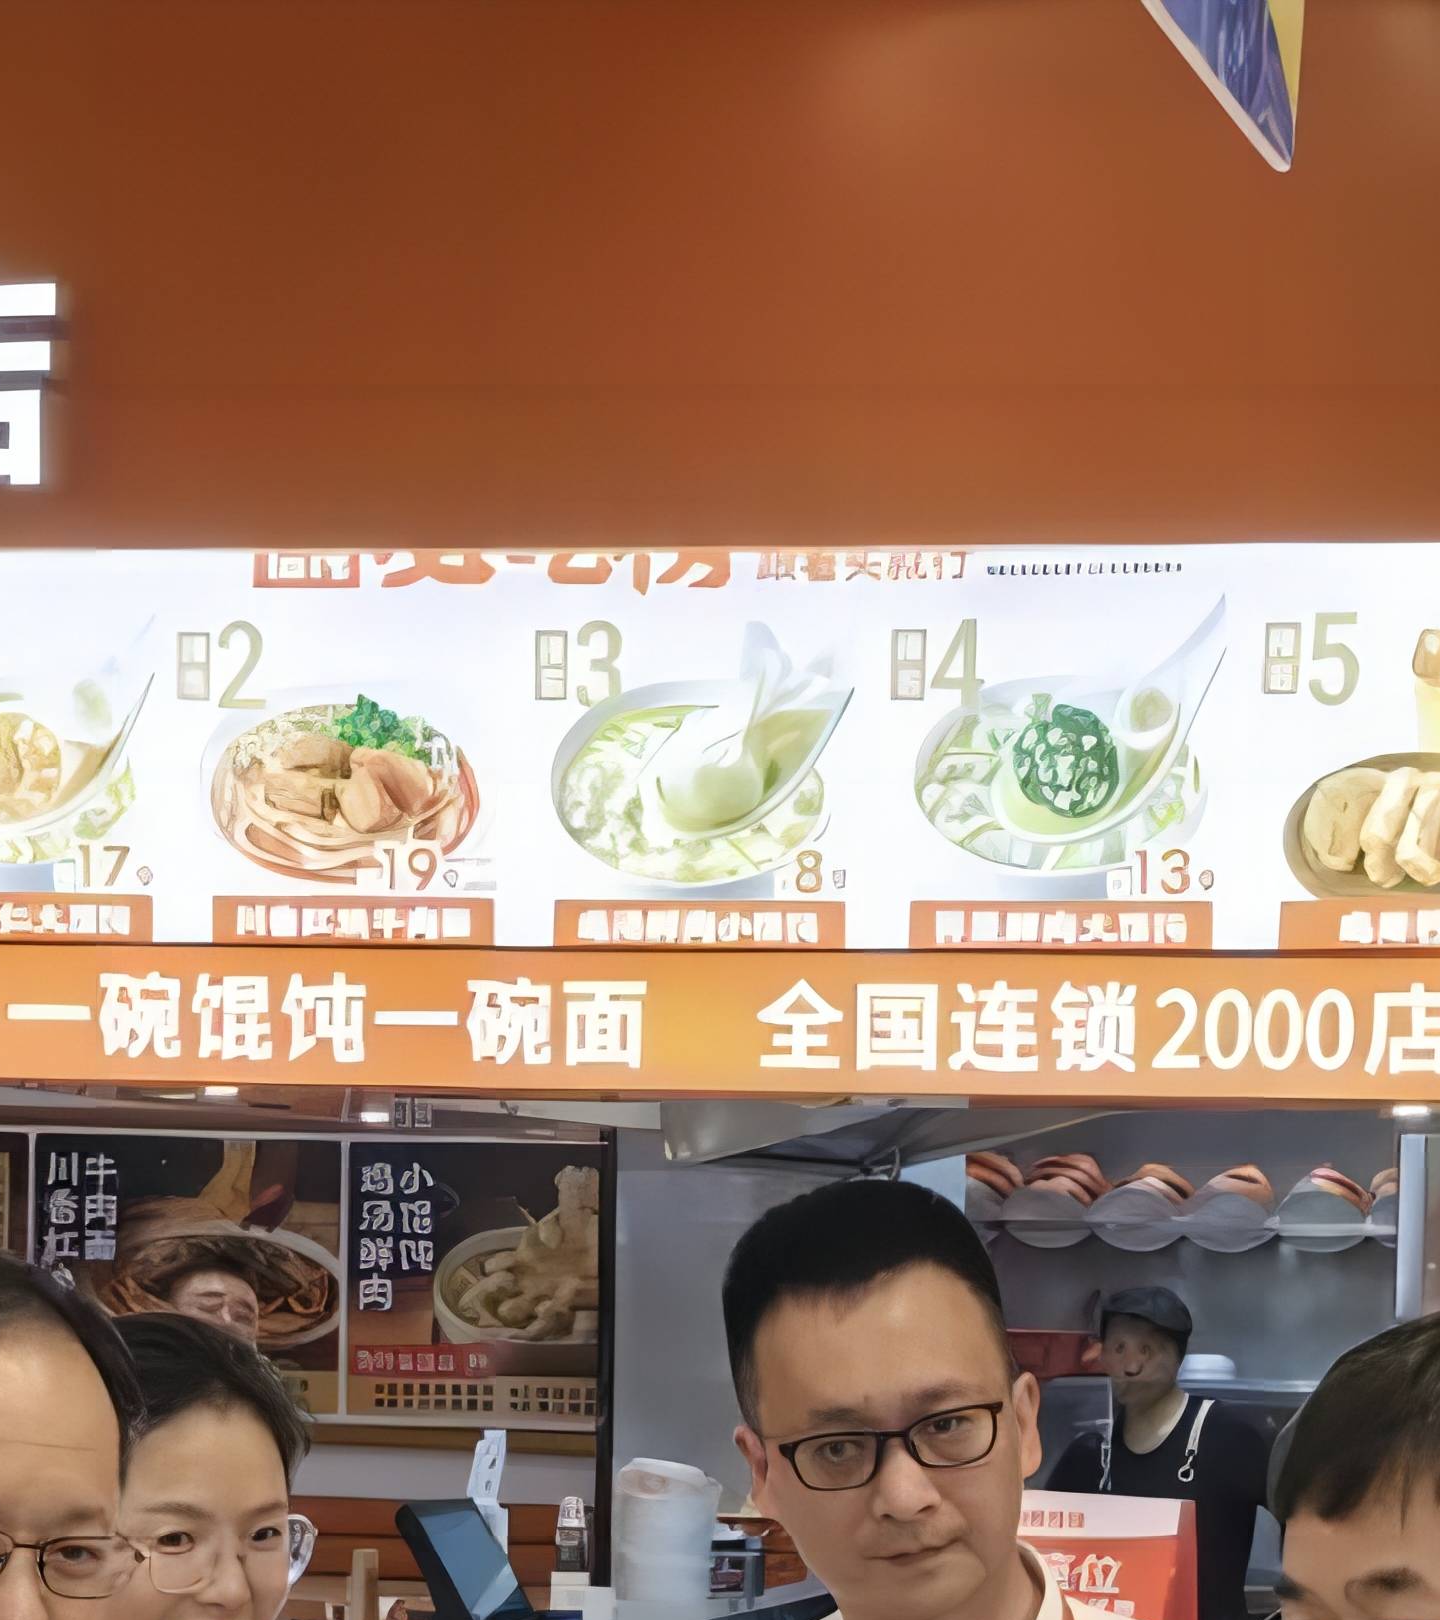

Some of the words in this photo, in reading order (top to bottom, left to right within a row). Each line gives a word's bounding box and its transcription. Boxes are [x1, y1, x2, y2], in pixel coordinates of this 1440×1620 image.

[217, 619, 268, 709] 2
[575, 619, 623, 708] 3
[930, 618, 985, 707] 4
[1308, 611, 1360, 706] 5
[6, 970, 648, 1069] 一碗馄饨一碗面
